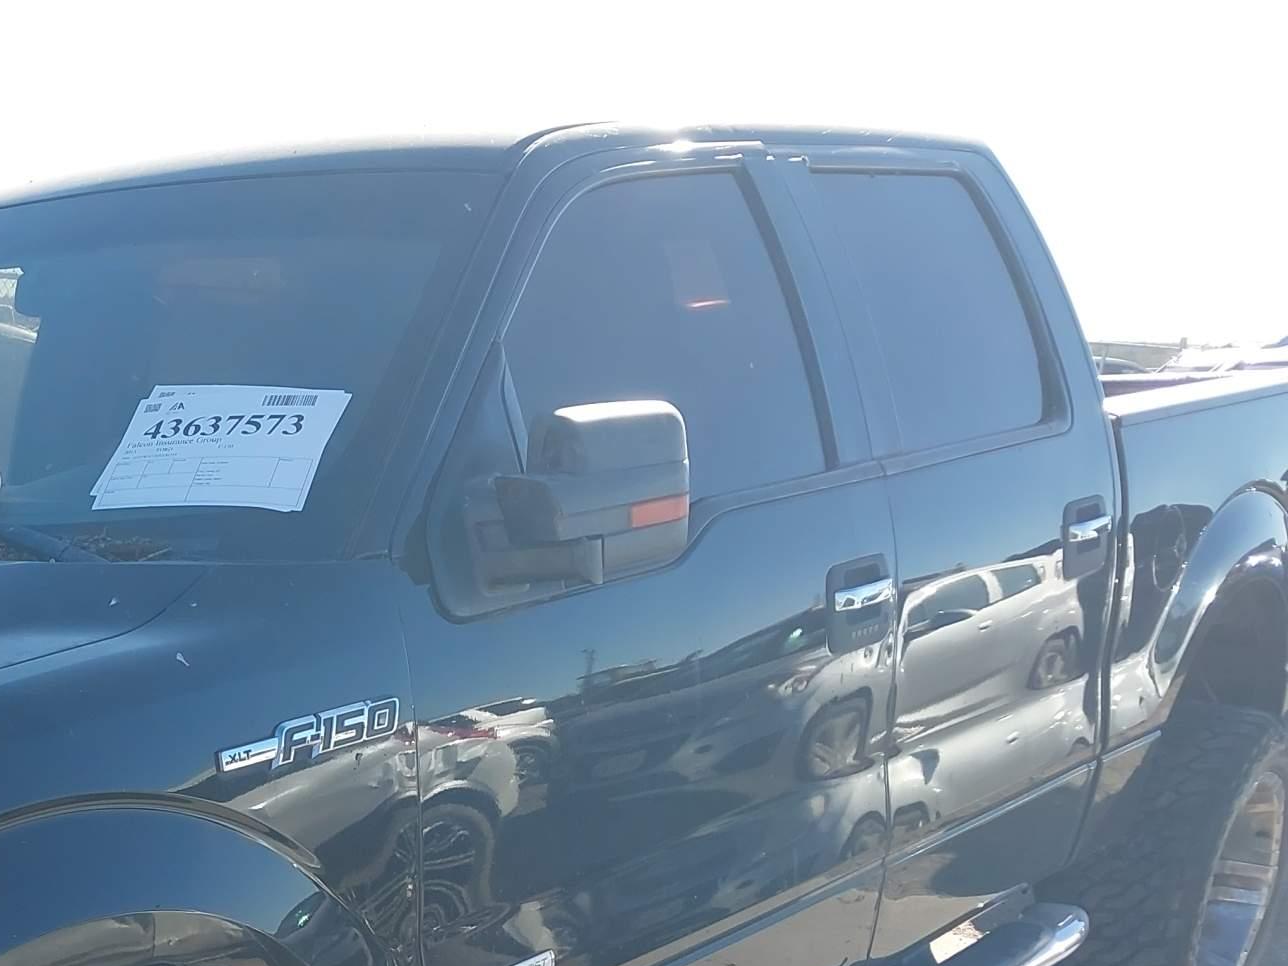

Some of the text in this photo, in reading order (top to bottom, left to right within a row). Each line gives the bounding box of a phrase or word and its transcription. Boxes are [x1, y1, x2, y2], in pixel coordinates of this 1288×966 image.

[143, 414, 304, 440] 43637573
[155, 438, 193, 447] Insurance
[196, 437, 222, 446] Group
[275, 697, 400, 769] F-150
[228, 748, 253, 764] XLT
